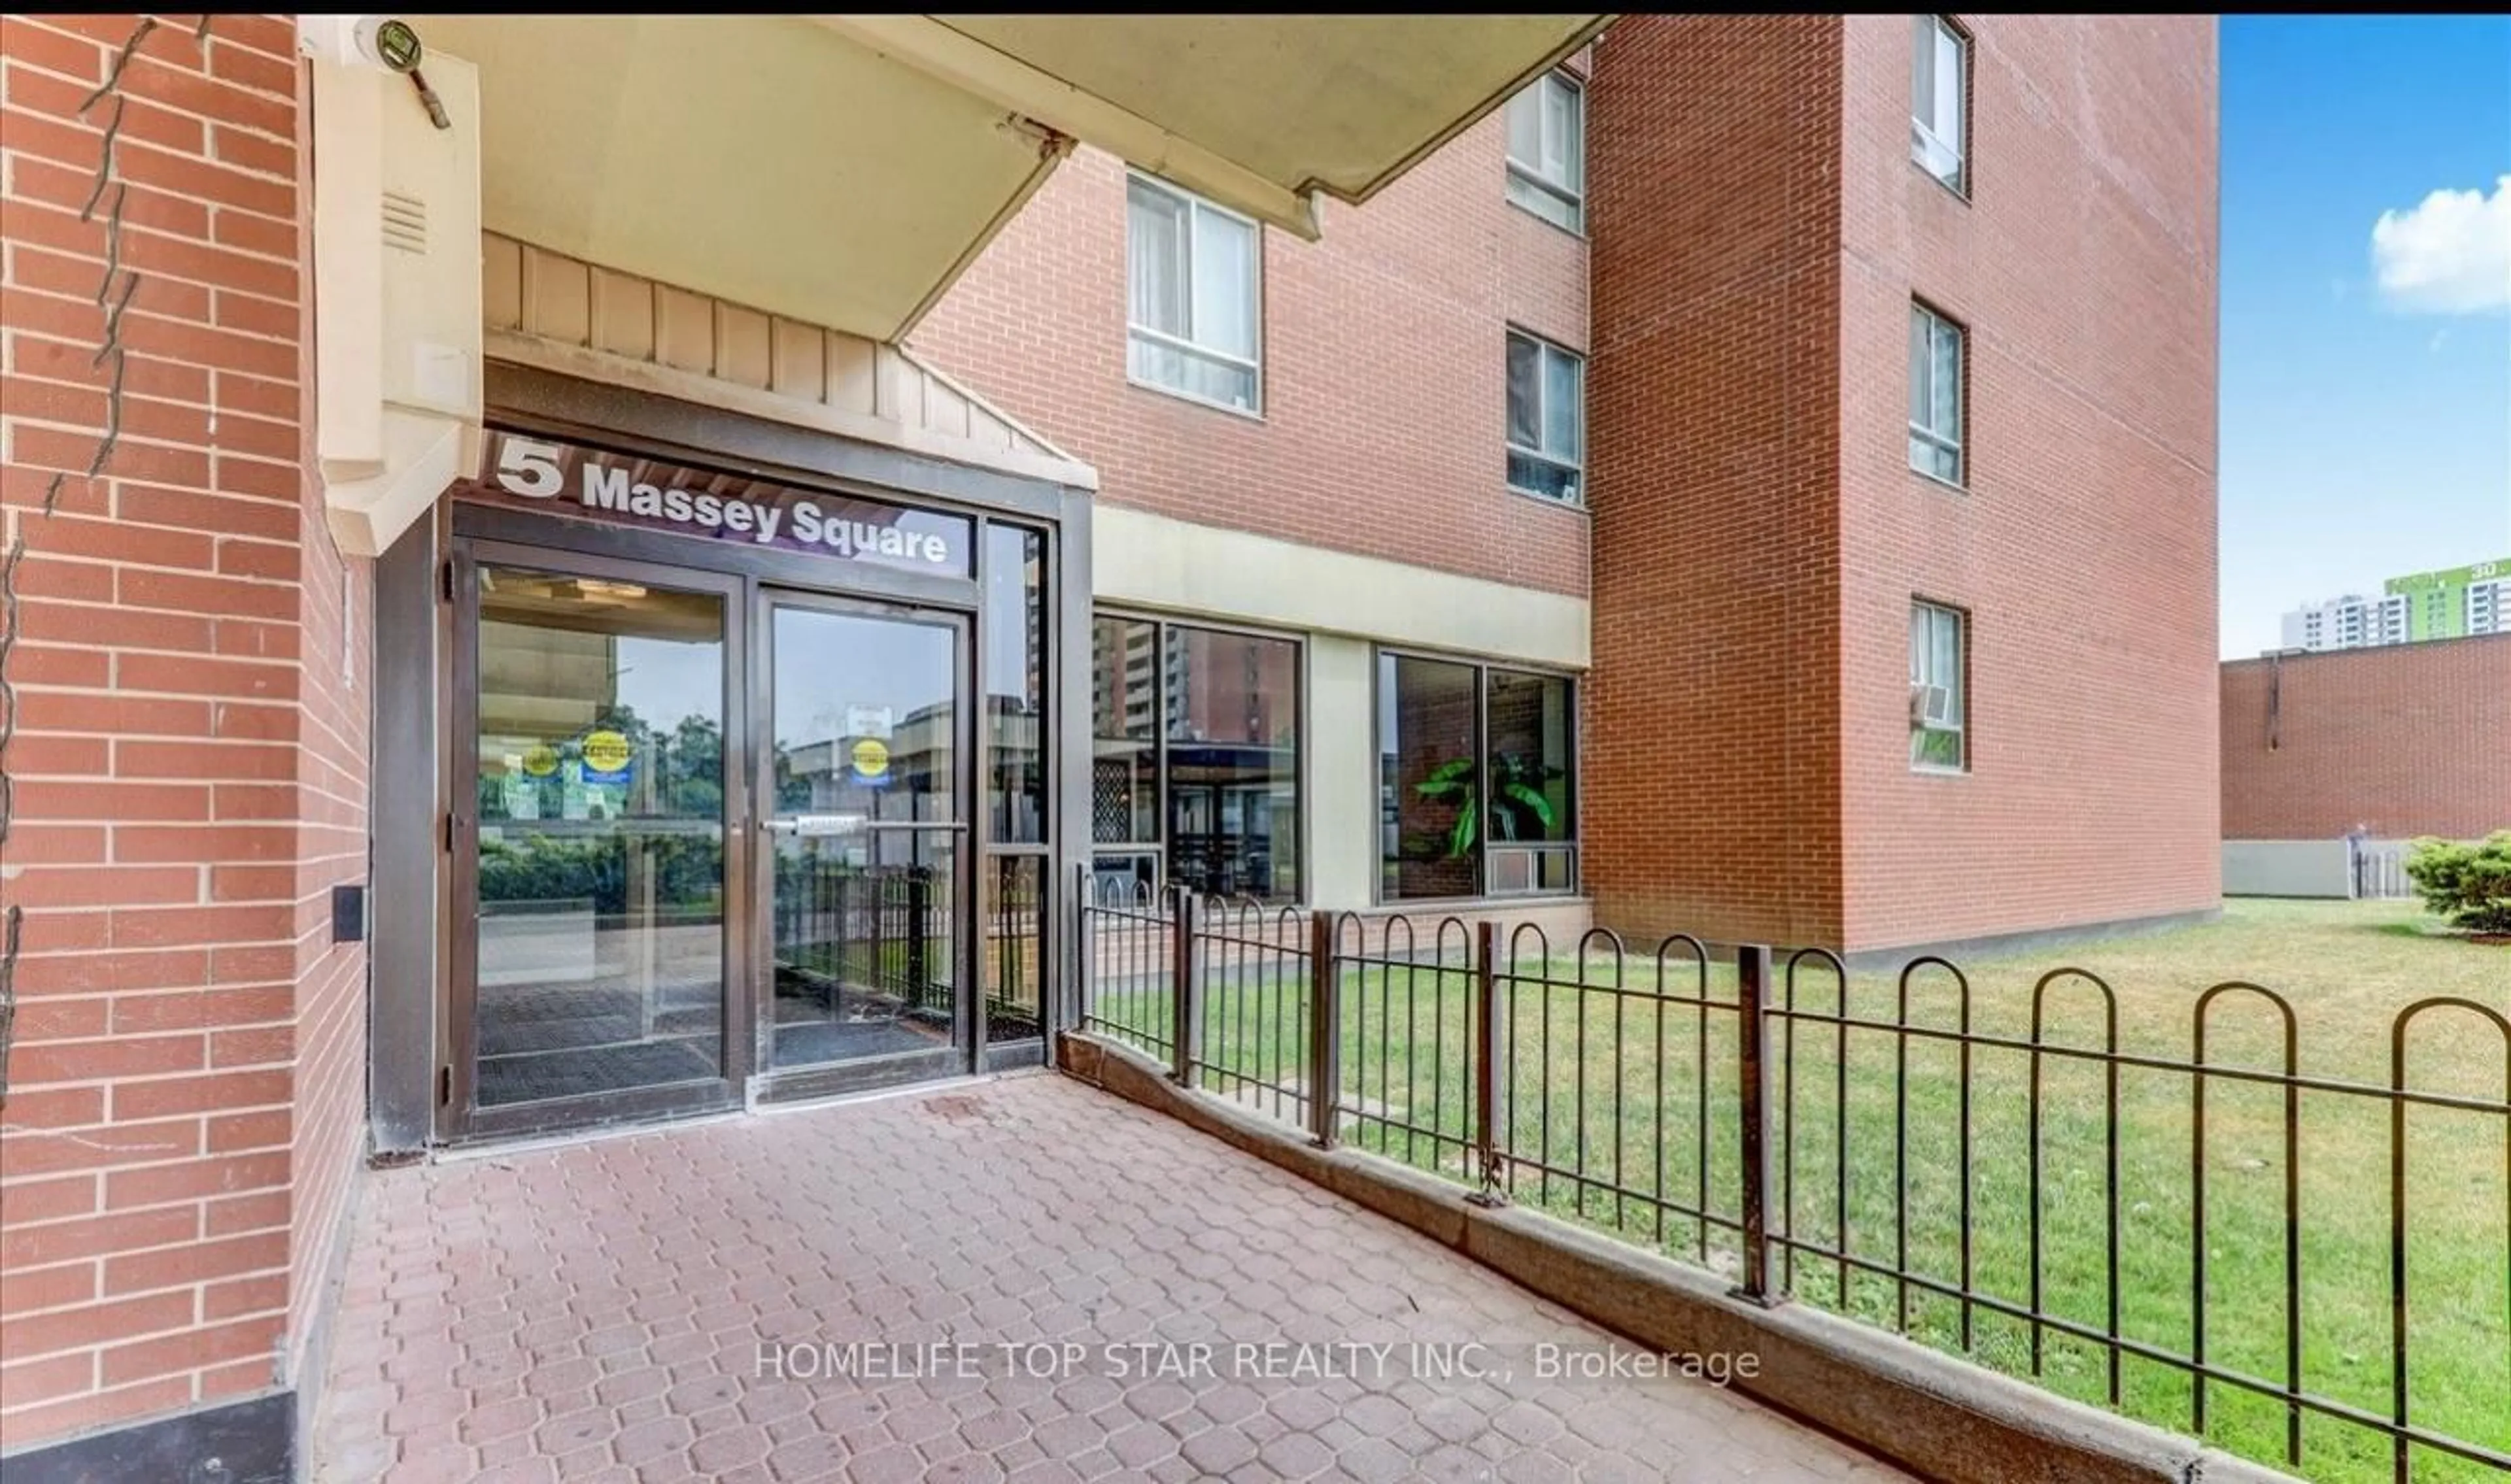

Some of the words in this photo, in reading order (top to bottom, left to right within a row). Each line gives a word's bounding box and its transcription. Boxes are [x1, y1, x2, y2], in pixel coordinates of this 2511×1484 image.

[497, 437, 564, 498] 5
[583, 462, 783, 543] Massey
[791, 501, 948, 562] Square
